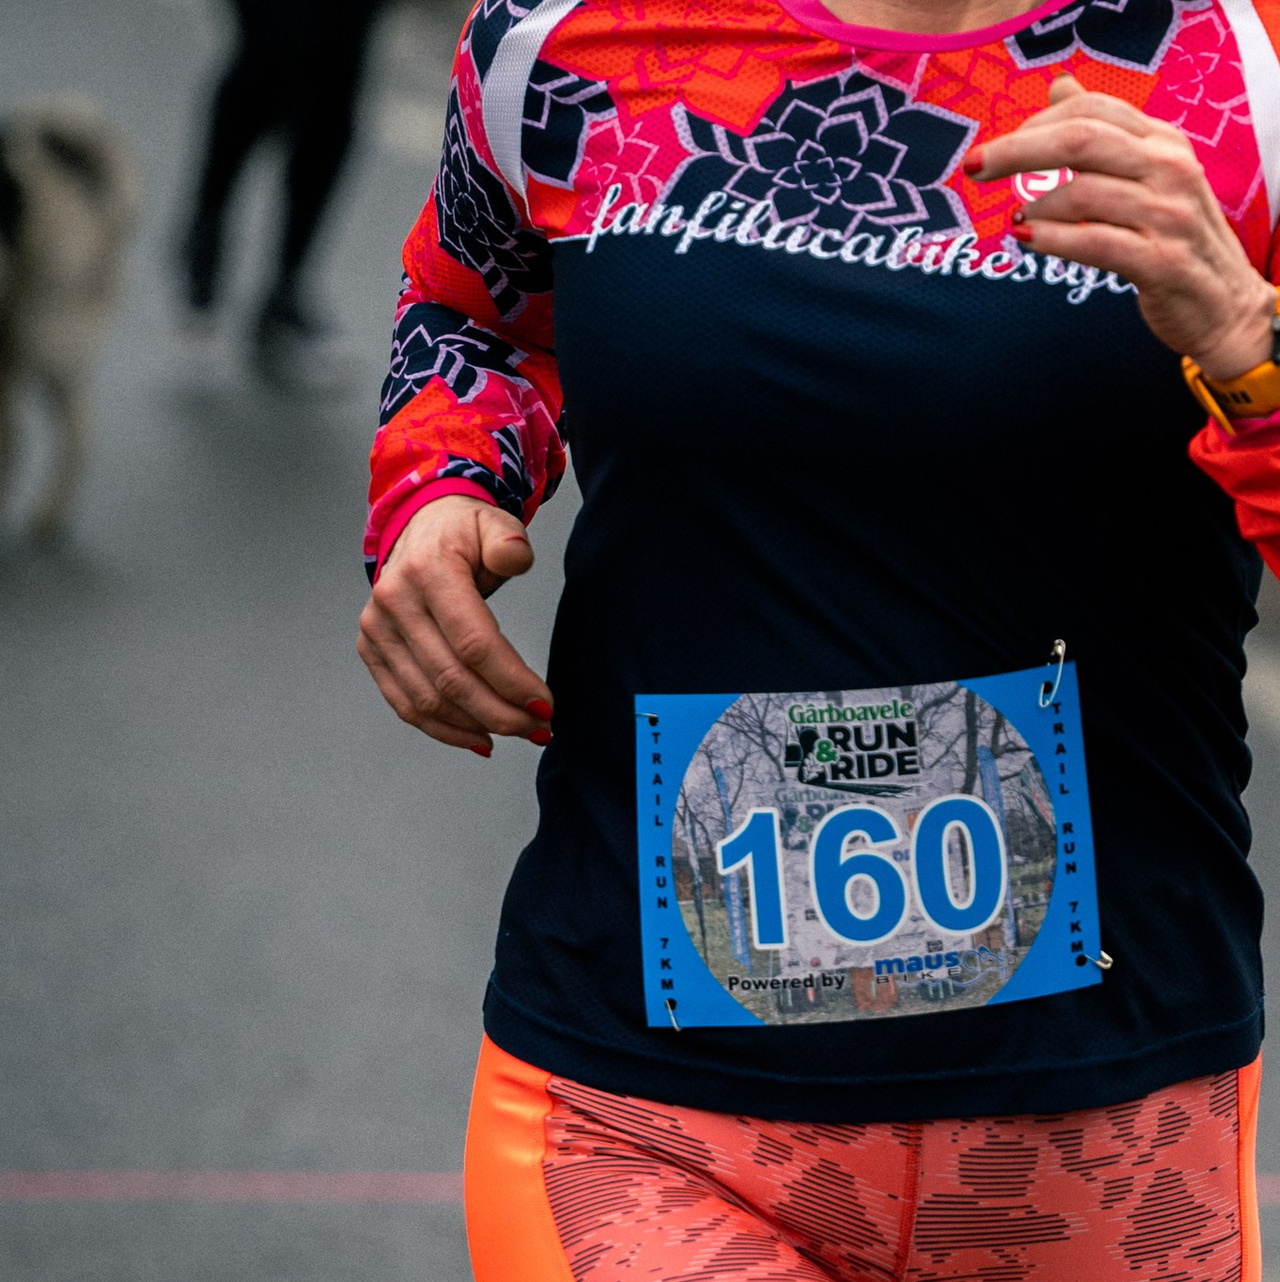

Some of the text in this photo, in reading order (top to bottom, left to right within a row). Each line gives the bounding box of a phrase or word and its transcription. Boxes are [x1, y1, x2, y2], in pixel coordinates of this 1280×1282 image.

[788, 699, 914, 725] Gârboavele
[826, 720, 917, 753] RUN
[829, 749, 920, 781] RIDE
[1052, 702, 1084, 953] TRAIL RUN 7KM
[651, 732, 674, 991] TRAIL RUN 7KM
[718, 795, 1006, 949] 160
[875, 950, 960, 976] maus
[876, 967, 962, 985] BIKE
[728, 972, 845, 991] Powered by
